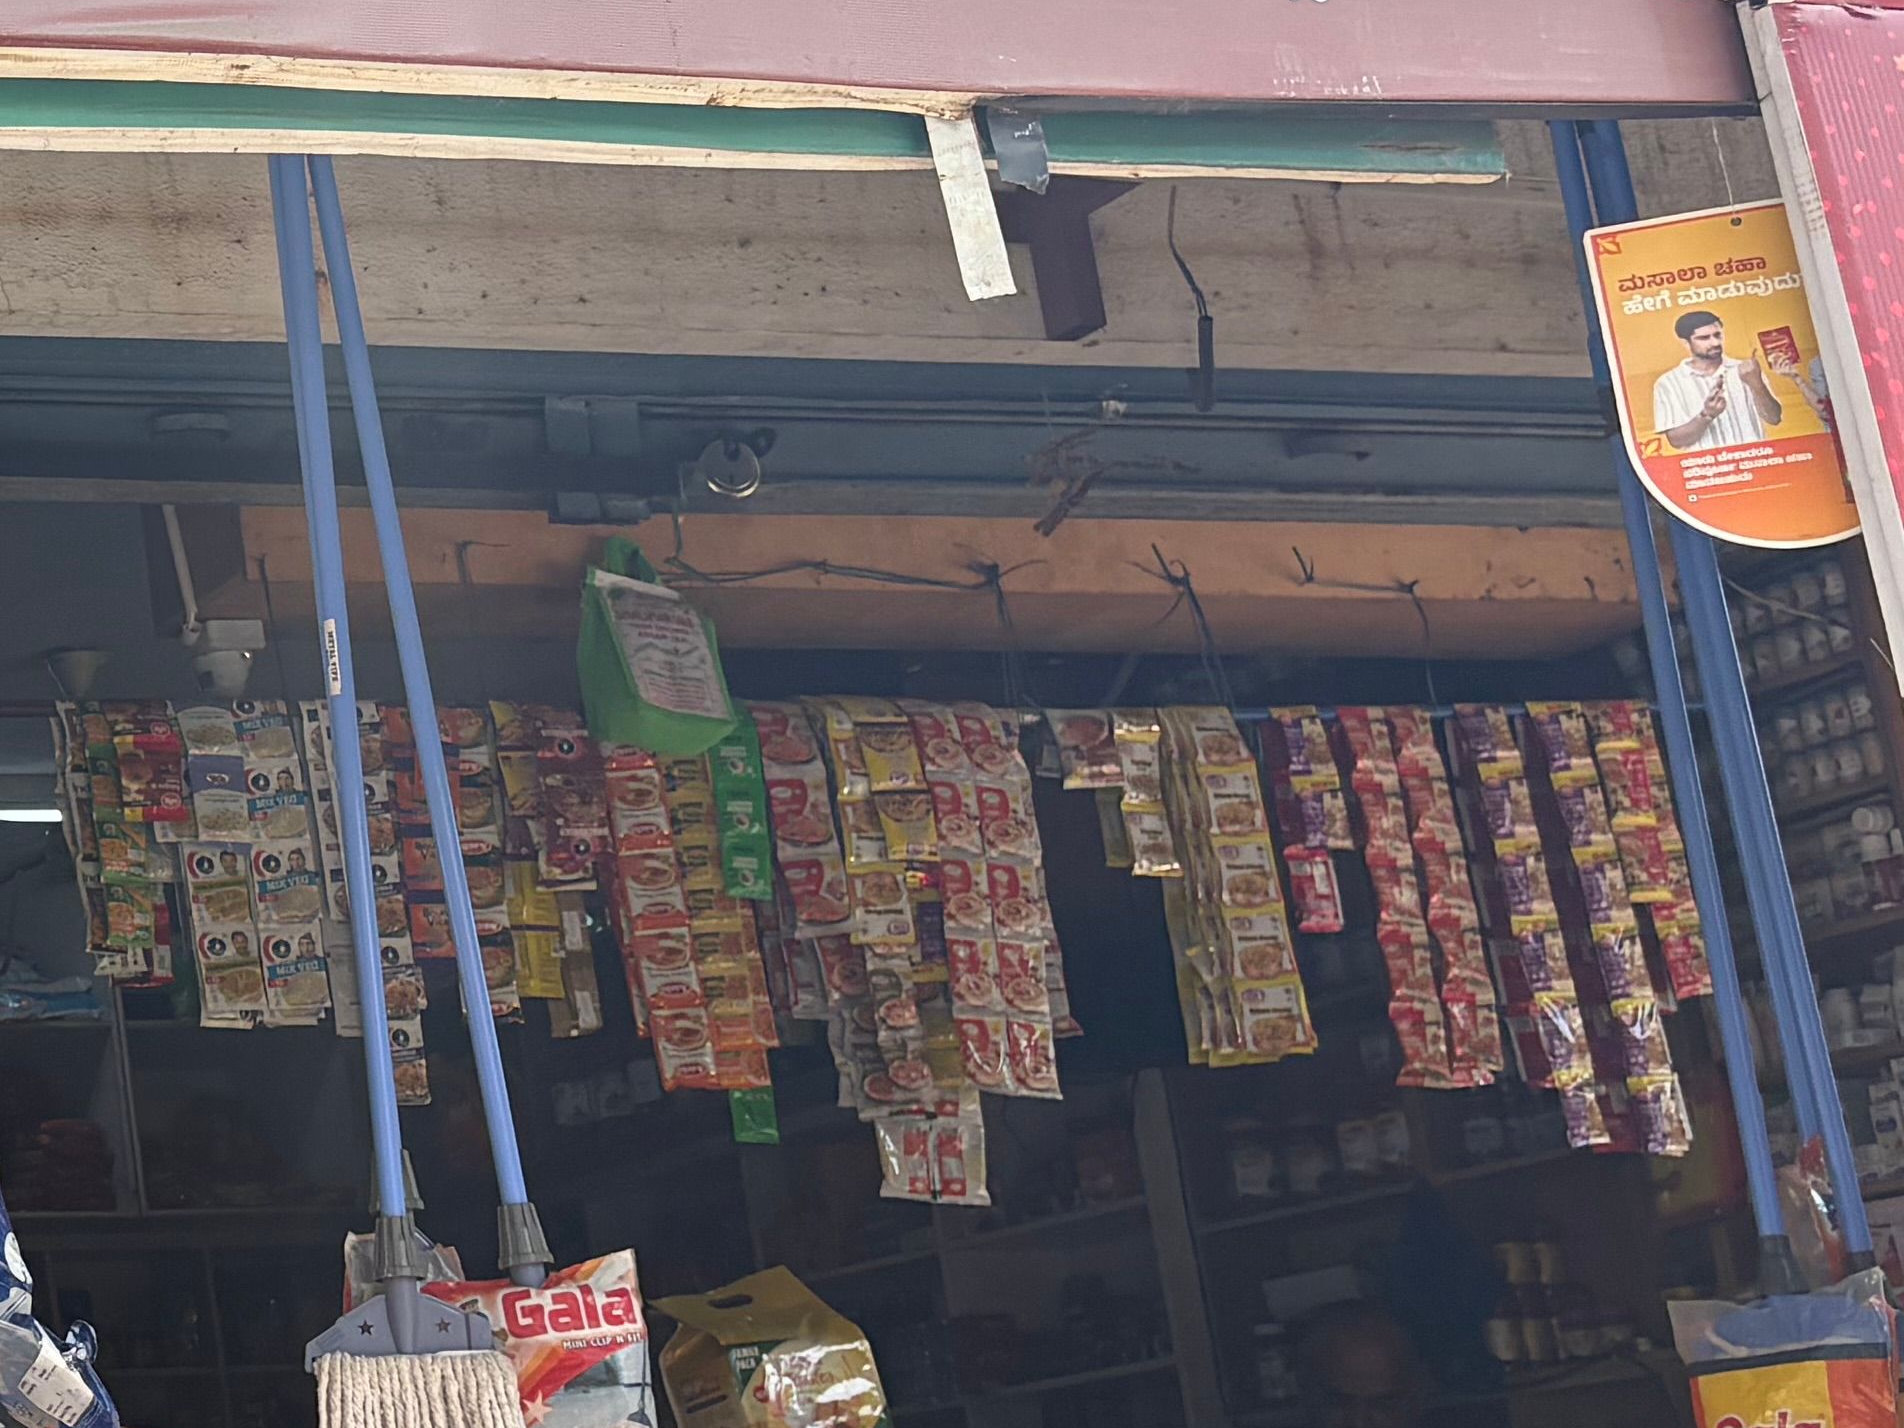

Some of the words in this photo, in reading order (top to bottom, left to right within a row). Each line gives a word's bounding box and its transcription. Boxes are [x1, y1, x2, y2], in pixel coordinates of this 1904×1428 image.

[1618, 263, 1708, 294] ಮಸಾಲಾ
[1713, 255, 1767, 277] ಚಹಾ
[1622, 291, 1672, 316] ಹೇಗೆ
[500, 1281, 639, 1339] Gala
[562, 1337, 587, 1350] MINI
[589, 1334, 613, 1348] CLIP
